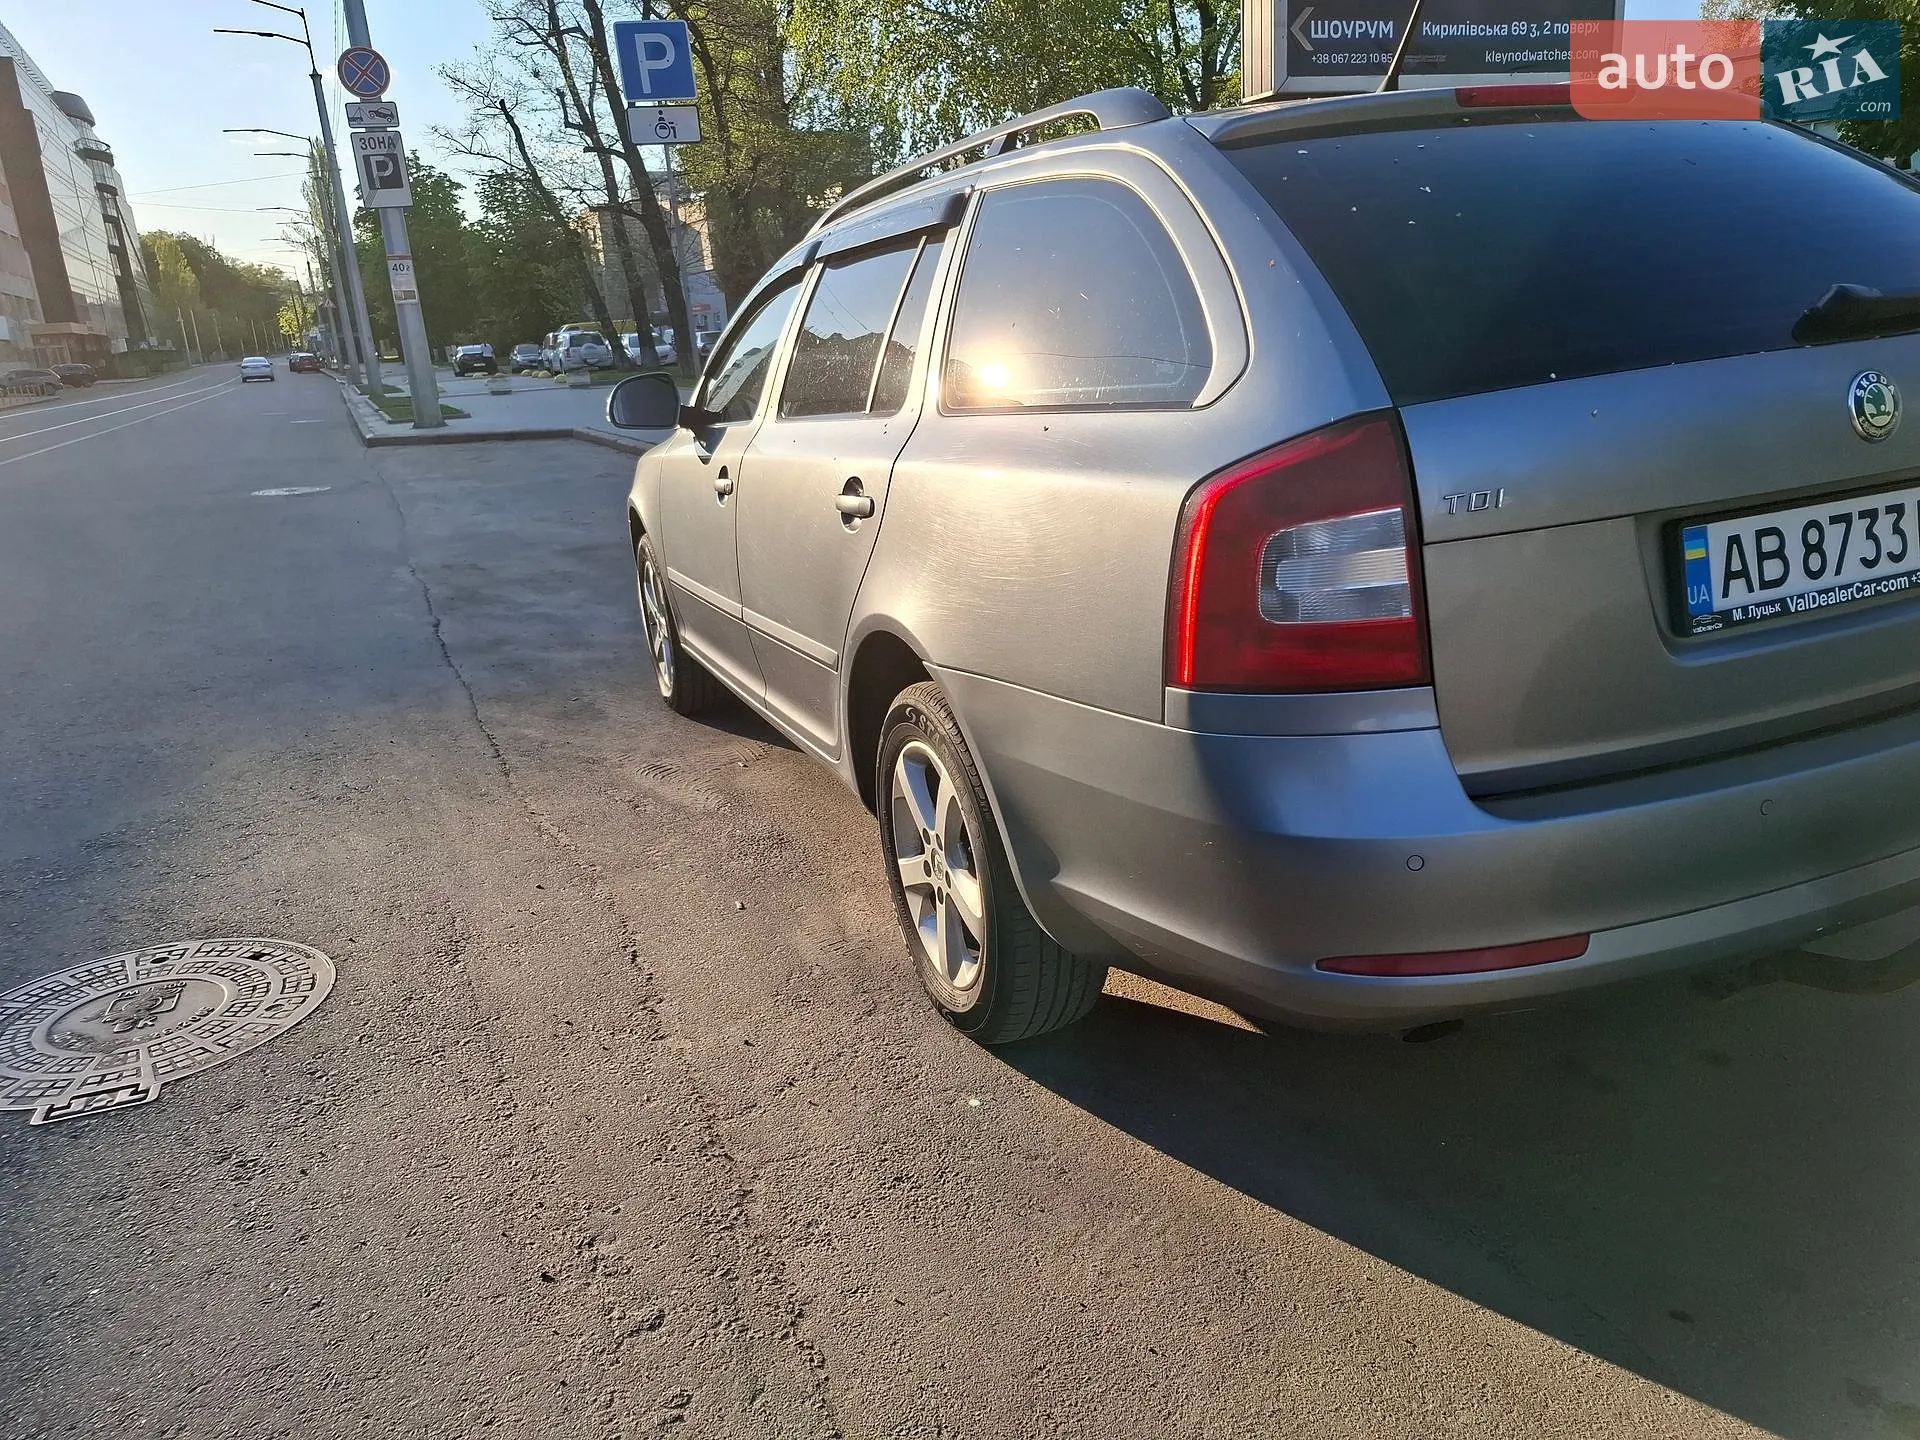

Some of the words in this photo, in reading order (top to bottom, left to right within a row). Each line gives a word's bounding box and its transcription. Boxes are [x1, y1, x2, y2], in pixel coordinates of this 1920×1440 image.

[1311, 20, 1393, 39] ШОУРУМ
[1423, 20, 1508, 39] Кирилівська
[1511, 21, 1527, 36] 69
[1543, 20, 1551, 35] 2
[635, 33, 675, 94] P
[1311, 53, 1329, 64] +38
[1331, 53, 1349, 64] 067
[1350, 53, 1367, 64] 223
[1369, 53, 1379, 63] 10
[1381, 52, 1393, 63] 85
[1485, 49, 1599, 65] kleynodwatches.com
[359, 136, 397, 151] ЗОНА
[370, 155, 394, 189] P
[1443, 488, 1505, 515] TDI
[1721, 526, 1790, 599] AB
[1801, 503, 1909, 580] 8733
[1687, 584, 1711, 605] UA
[1748, 603, 1781, 619] Луцьк
[1786, 576, 1909, 613] ValDealerCar-com
